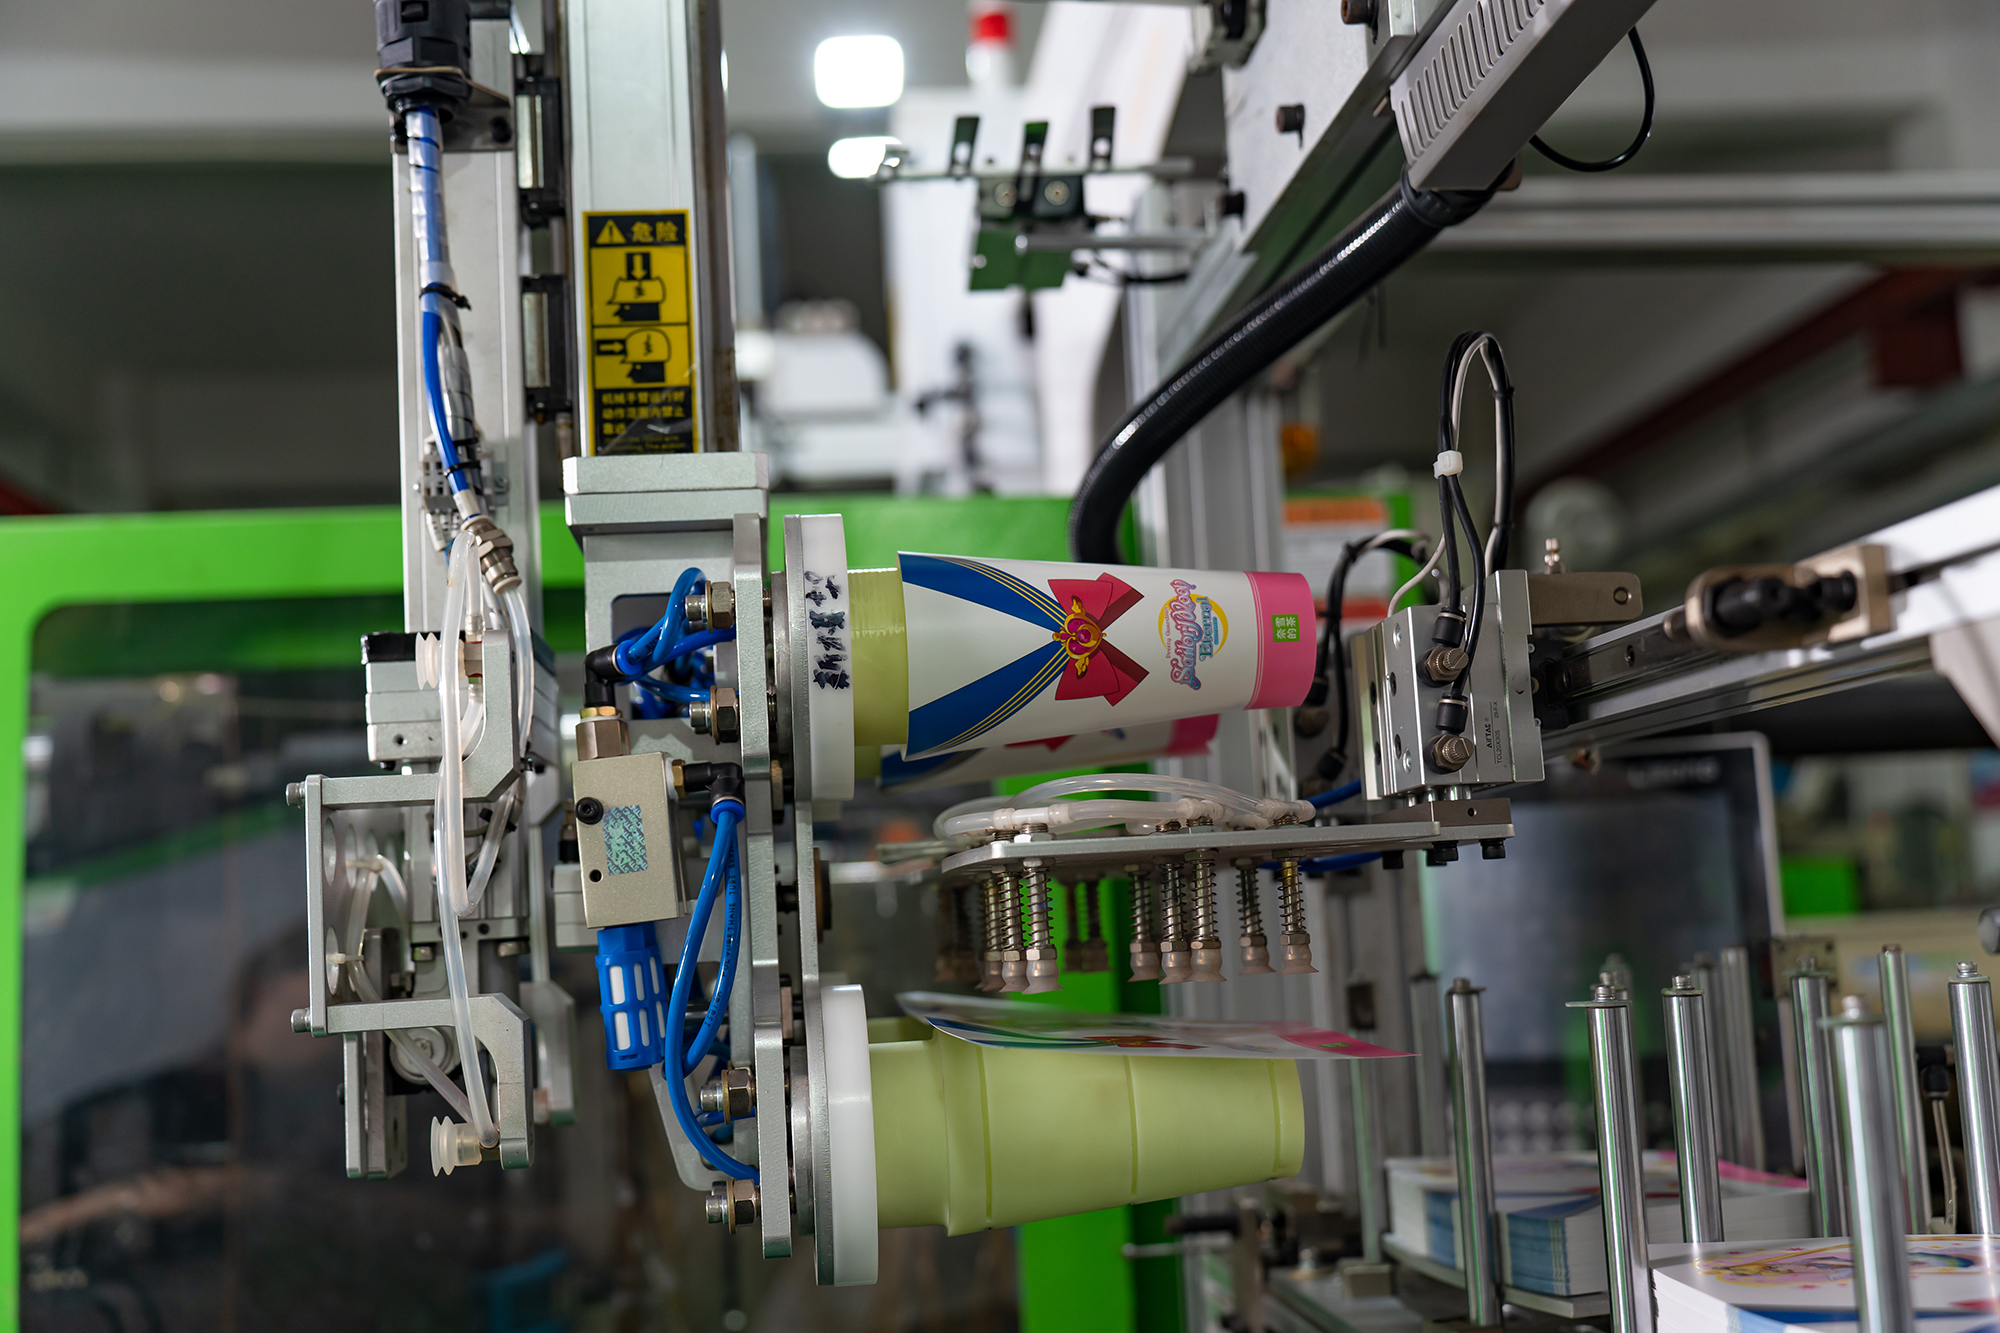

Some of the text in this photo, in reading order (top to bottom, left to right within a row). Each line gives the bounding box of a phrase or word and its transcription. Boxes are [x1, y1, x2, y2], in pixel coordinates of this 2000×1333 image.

[631, 221, 679, 242] 危险
[1170, 620, 1203, 690] Sailor
[1196, 596, 1213, 661] Eternal
